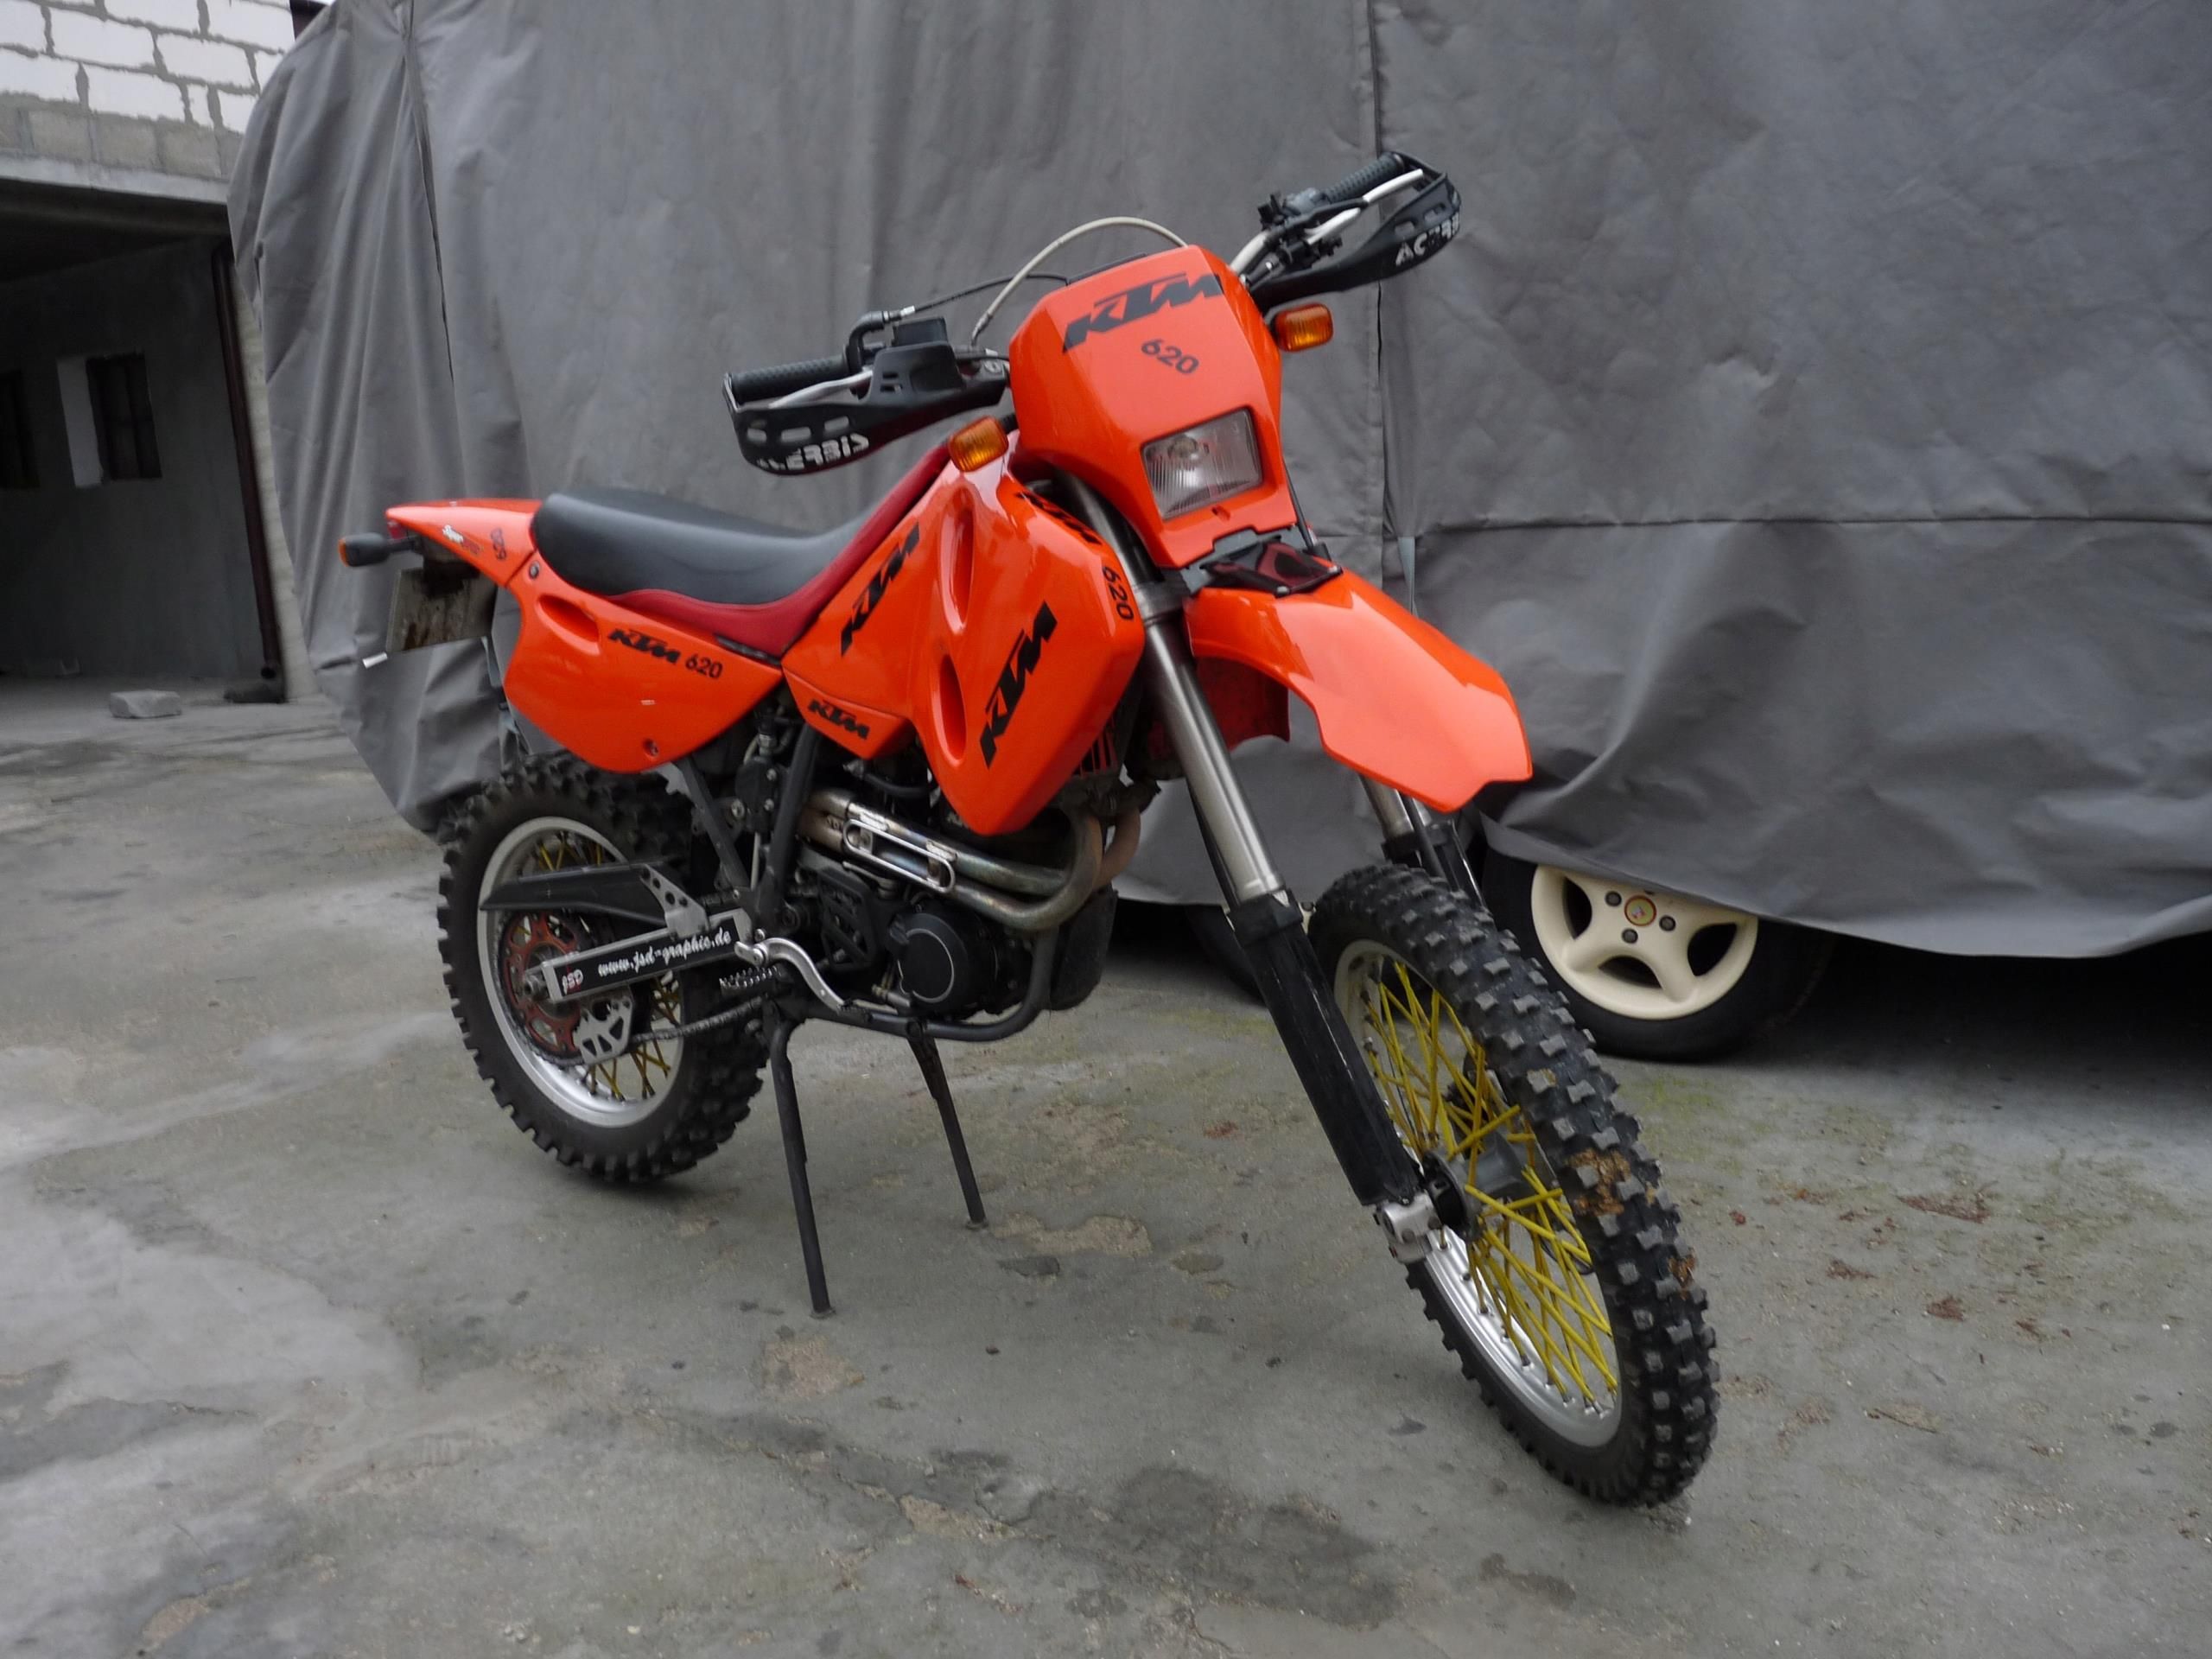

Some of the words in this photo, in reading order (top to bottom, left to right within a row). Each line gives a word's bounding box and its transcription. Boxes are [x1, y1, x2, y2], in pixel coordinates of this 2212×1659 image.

[1063, 272, 1224, 354] KTM
[1141, 338, 1200, 375] 620
[840, 520, 920, 658] KTM
[1102, 565, 1134, 620] 620
[608, 628, 680, 665] KTM
[685, 654, 723, 679] 620
[979, 600, 1058, 770] KTM
[808, 699, 870, 740] KTM
